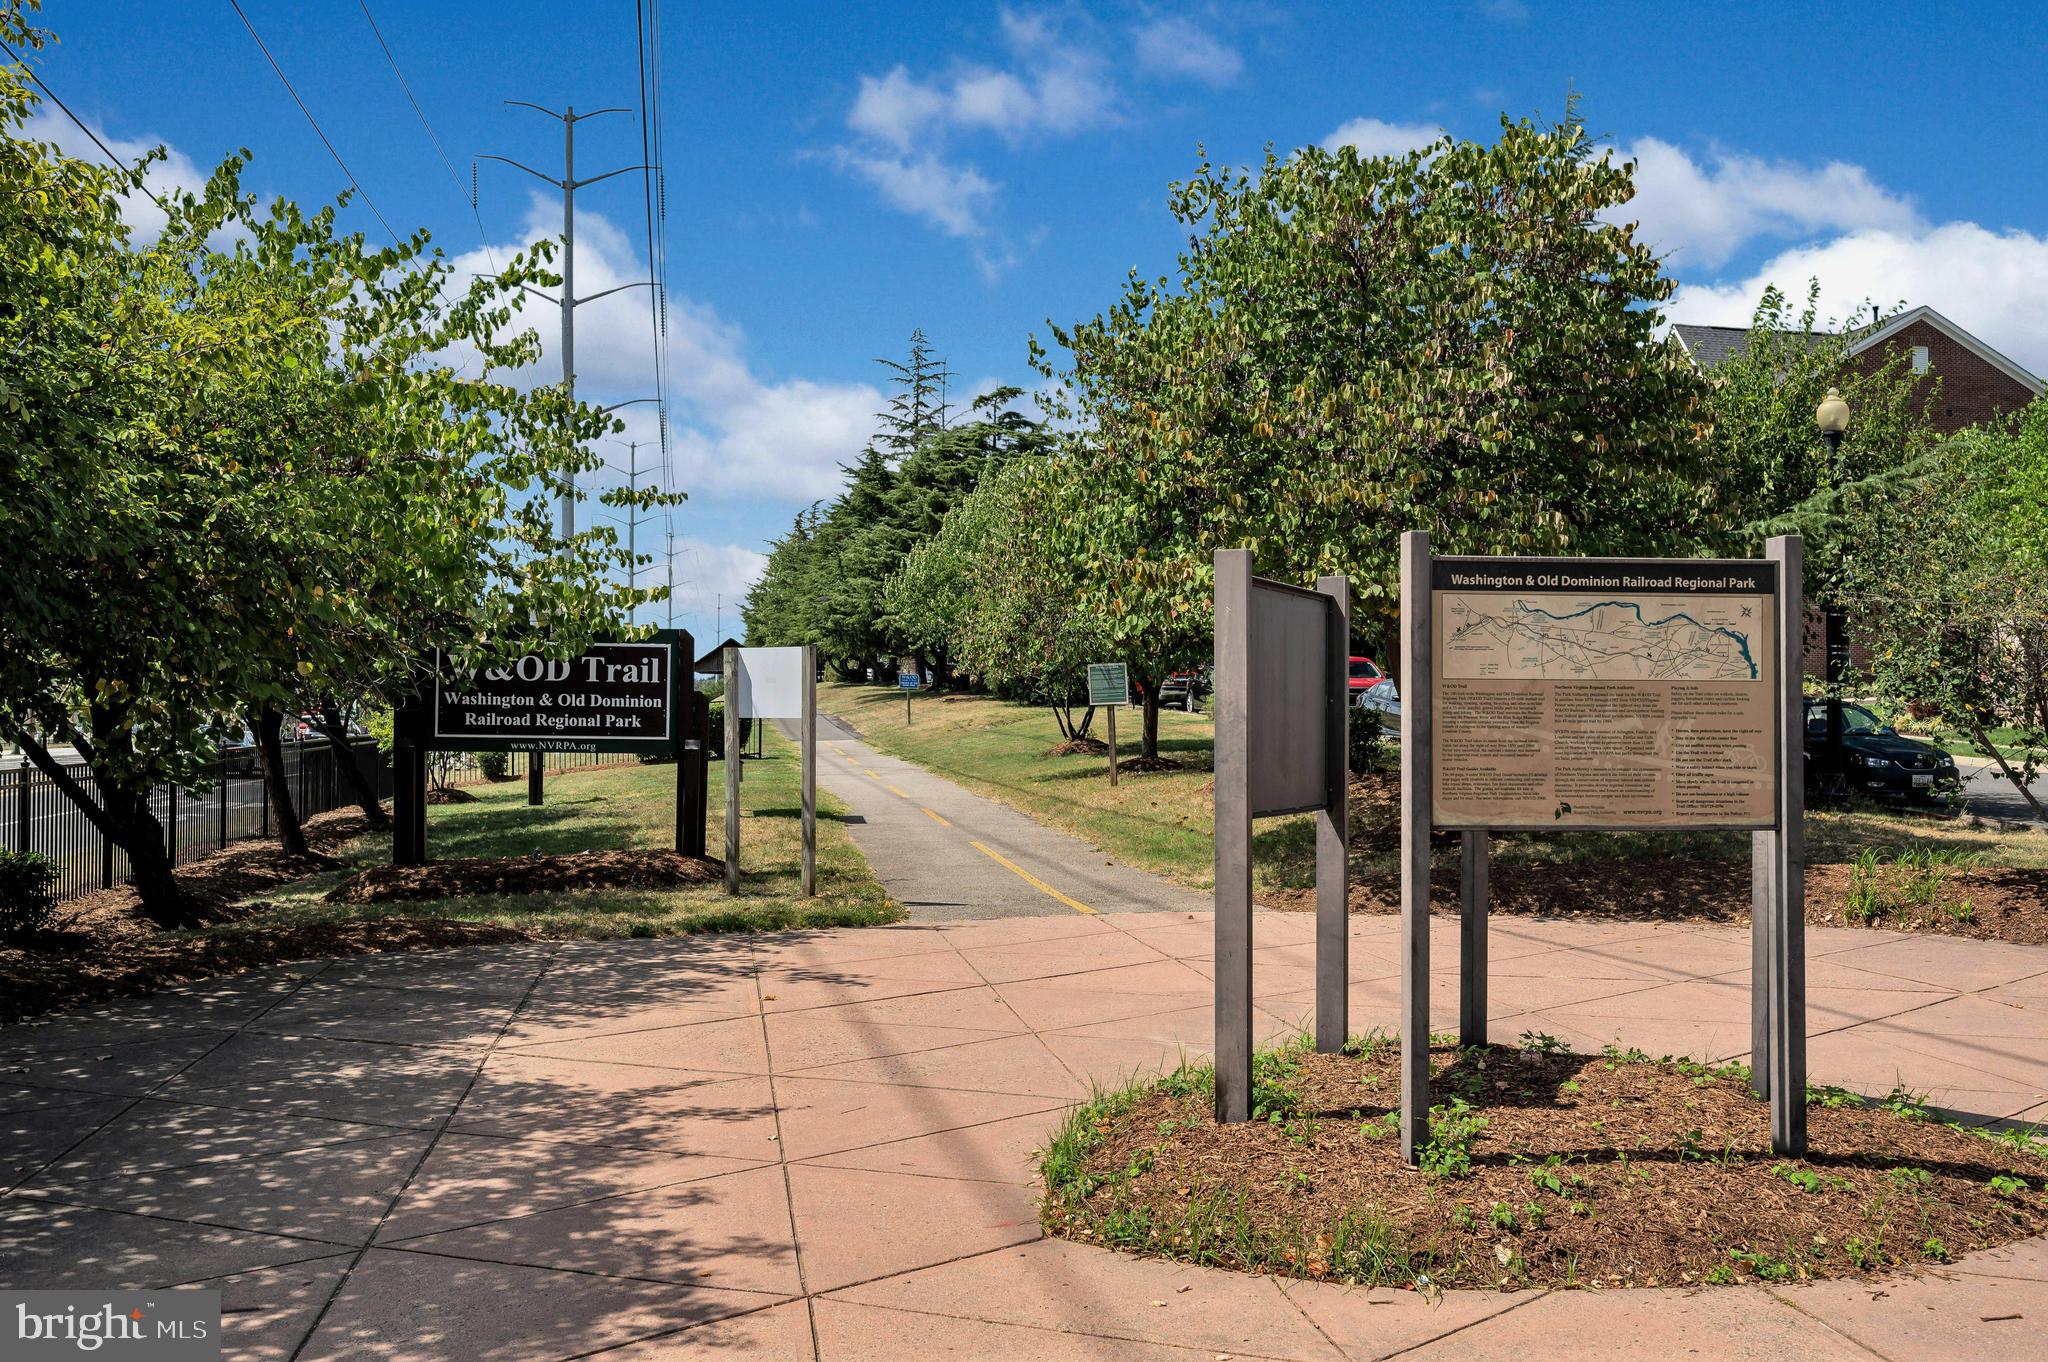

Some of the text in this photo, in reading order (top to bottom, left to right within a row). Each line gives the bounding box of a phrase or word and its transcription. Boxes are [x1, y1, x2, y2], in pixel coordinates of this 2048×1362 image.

[1451, 574, 1756, 590] Washington & Old Dominion Railroad Regional Park
[581, 656, 661, 683] Trail
[444, 691, 662, 709] Washington & Old Dominion
[465, 712, 642, 730] Railroad Regional Park
[510, 741, 596, 752] www.NVRPA.org
